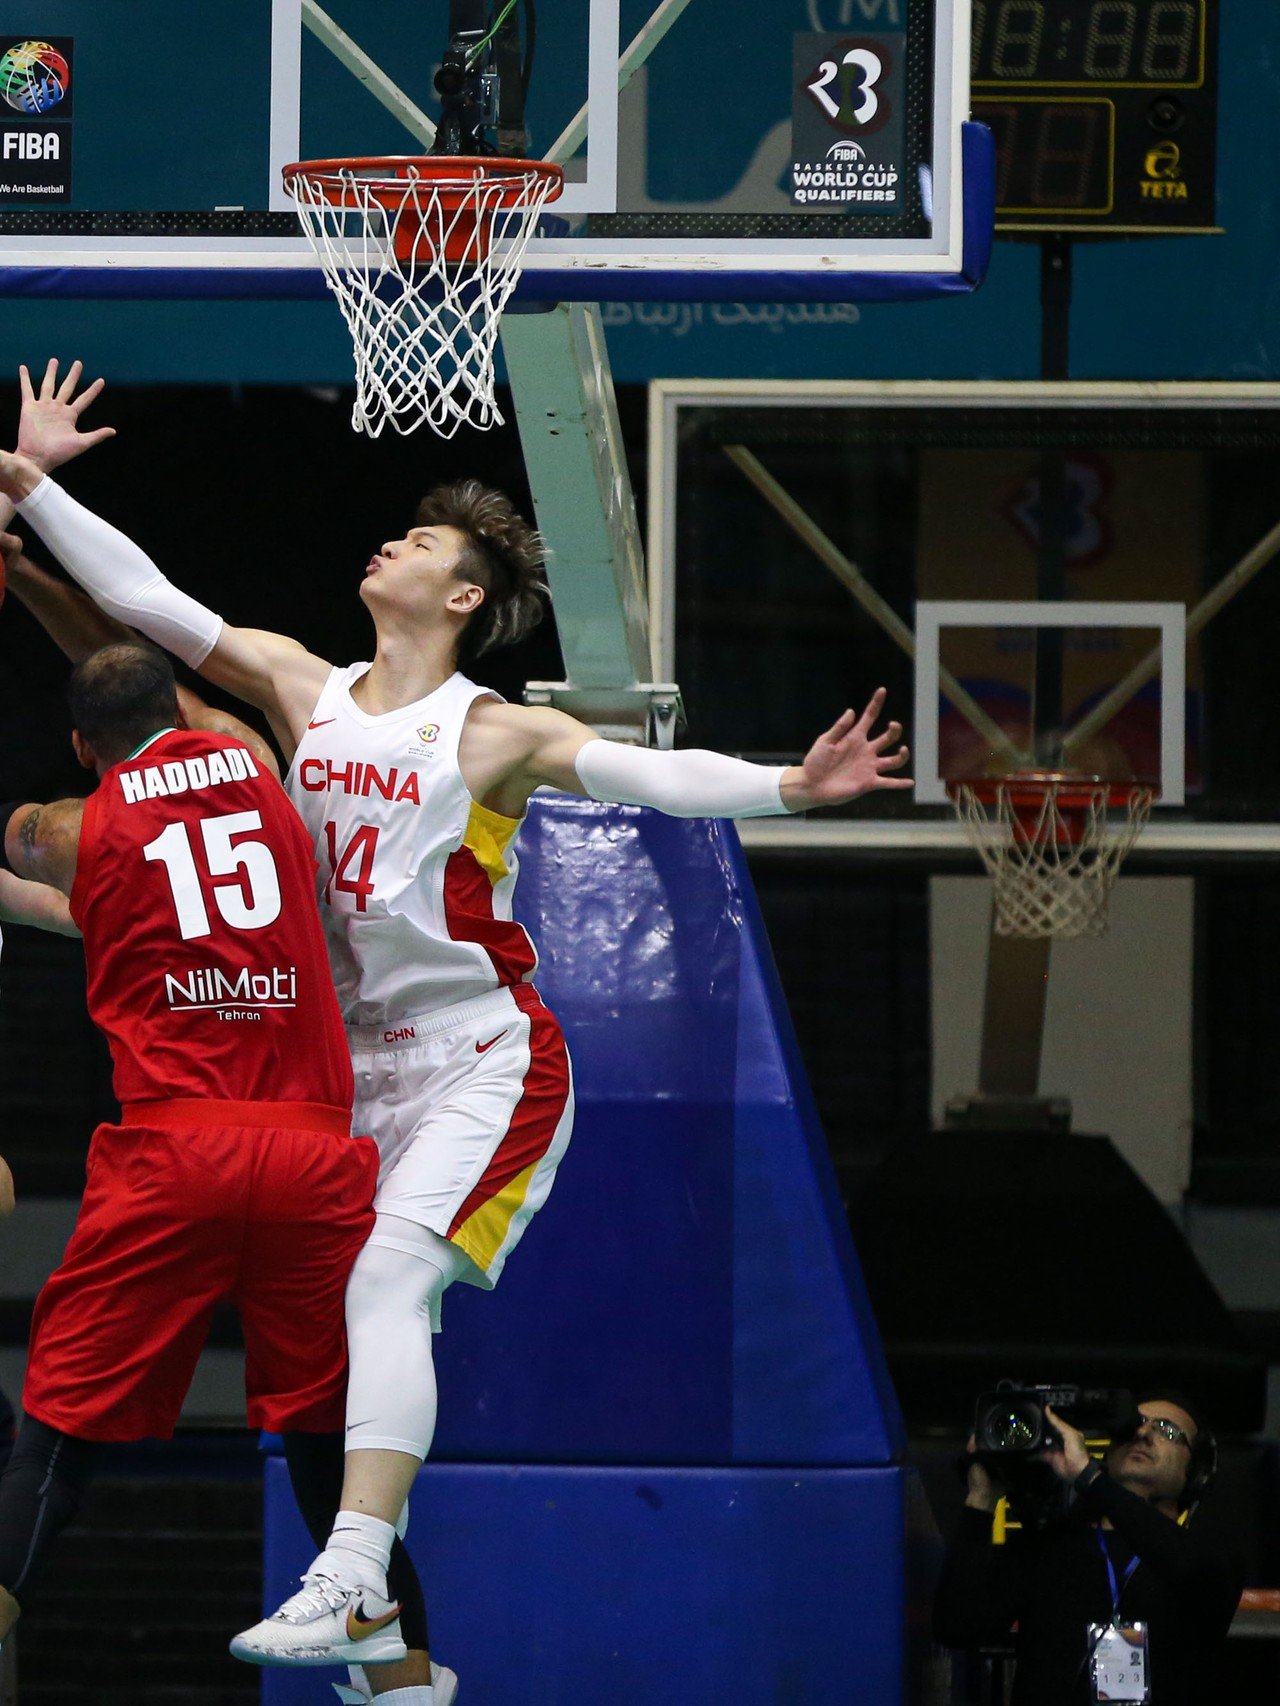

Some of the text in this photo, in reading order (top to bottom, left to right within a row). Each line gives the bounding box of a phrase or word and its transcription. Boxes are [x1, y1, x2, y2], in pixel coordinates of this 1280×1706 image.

[3, 132, 60, 160] FIBA
[833, 149, 858, 161] FIBA
[794, 163, 896, 171] BASKETBALL
[793, 172, 898, 187] WORLD CUP
[12, 184, 26, 193] Are
[26, 184, 64, 194] Basketball
[794, 189, 896, 203] QUALIFIERS
[1139, 181, 1188, 199] TETA
[119, 748, 259, 804] HADDADI
[300, 758, 421, 806] CHINA
[324, 820, 380, 912] 14
[143, 810, 282, 940] 15
[165, 967, 296, 1003] NilMoti
[217, 1010, 261, 1020] Tehran
[383, 1027, 416, 1043] CHN
